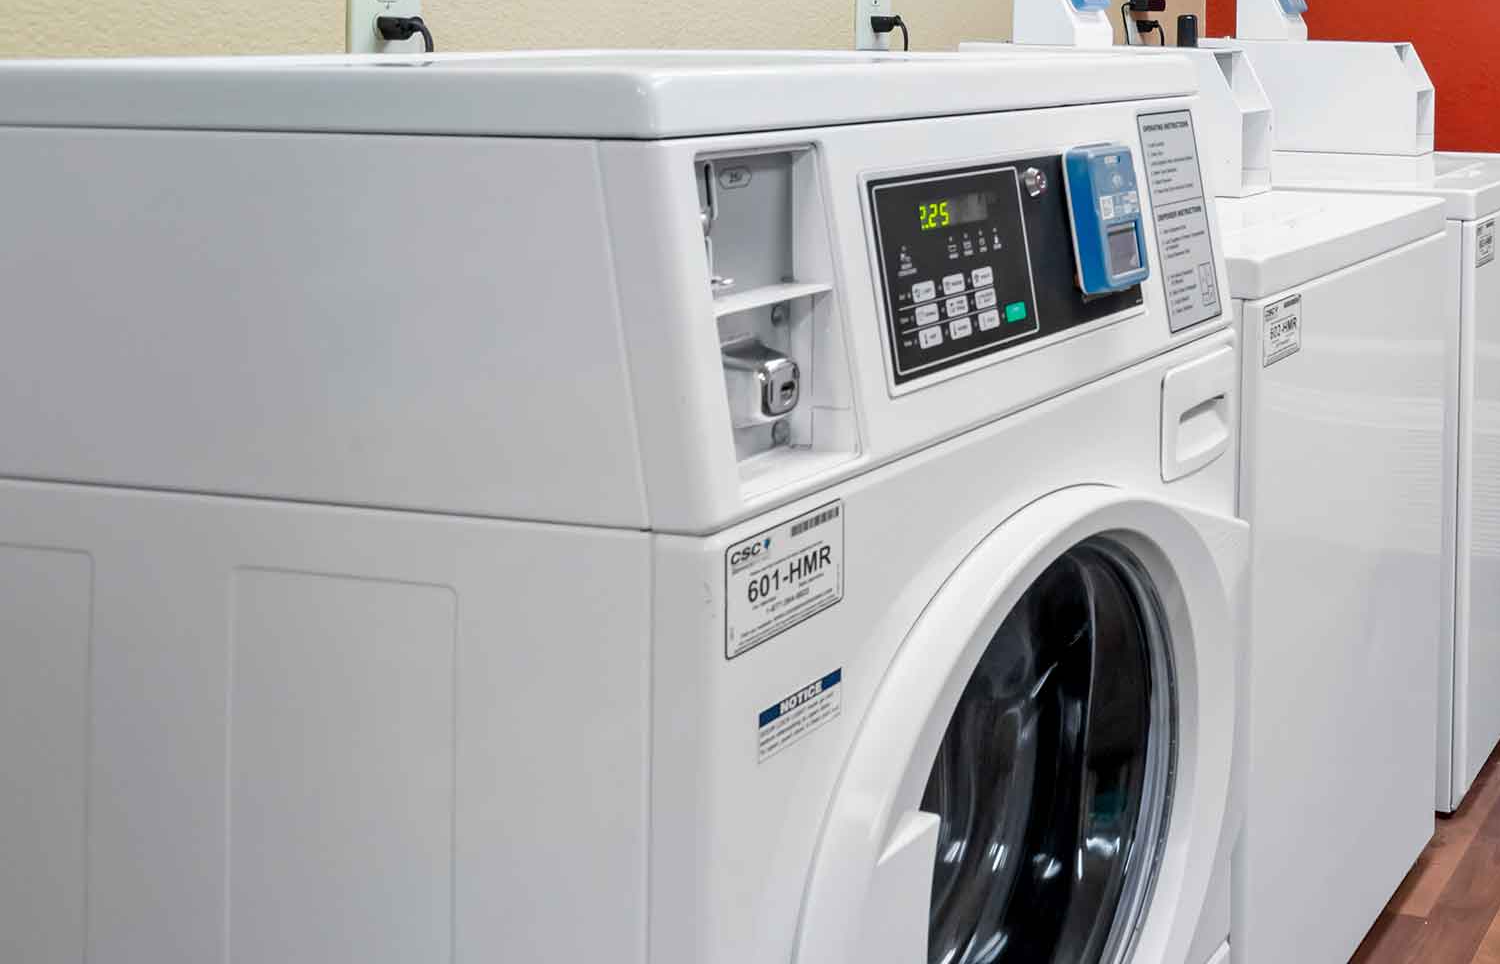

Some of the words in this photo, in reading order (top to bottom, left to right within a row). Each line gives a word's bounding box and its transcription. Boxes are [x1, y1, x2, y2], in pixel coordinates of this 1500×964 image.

[731, 542, 761, 565] CSC
[747, 545, 832, 603] 601-HMR
[780, 679, 823, 715] NOTICE
